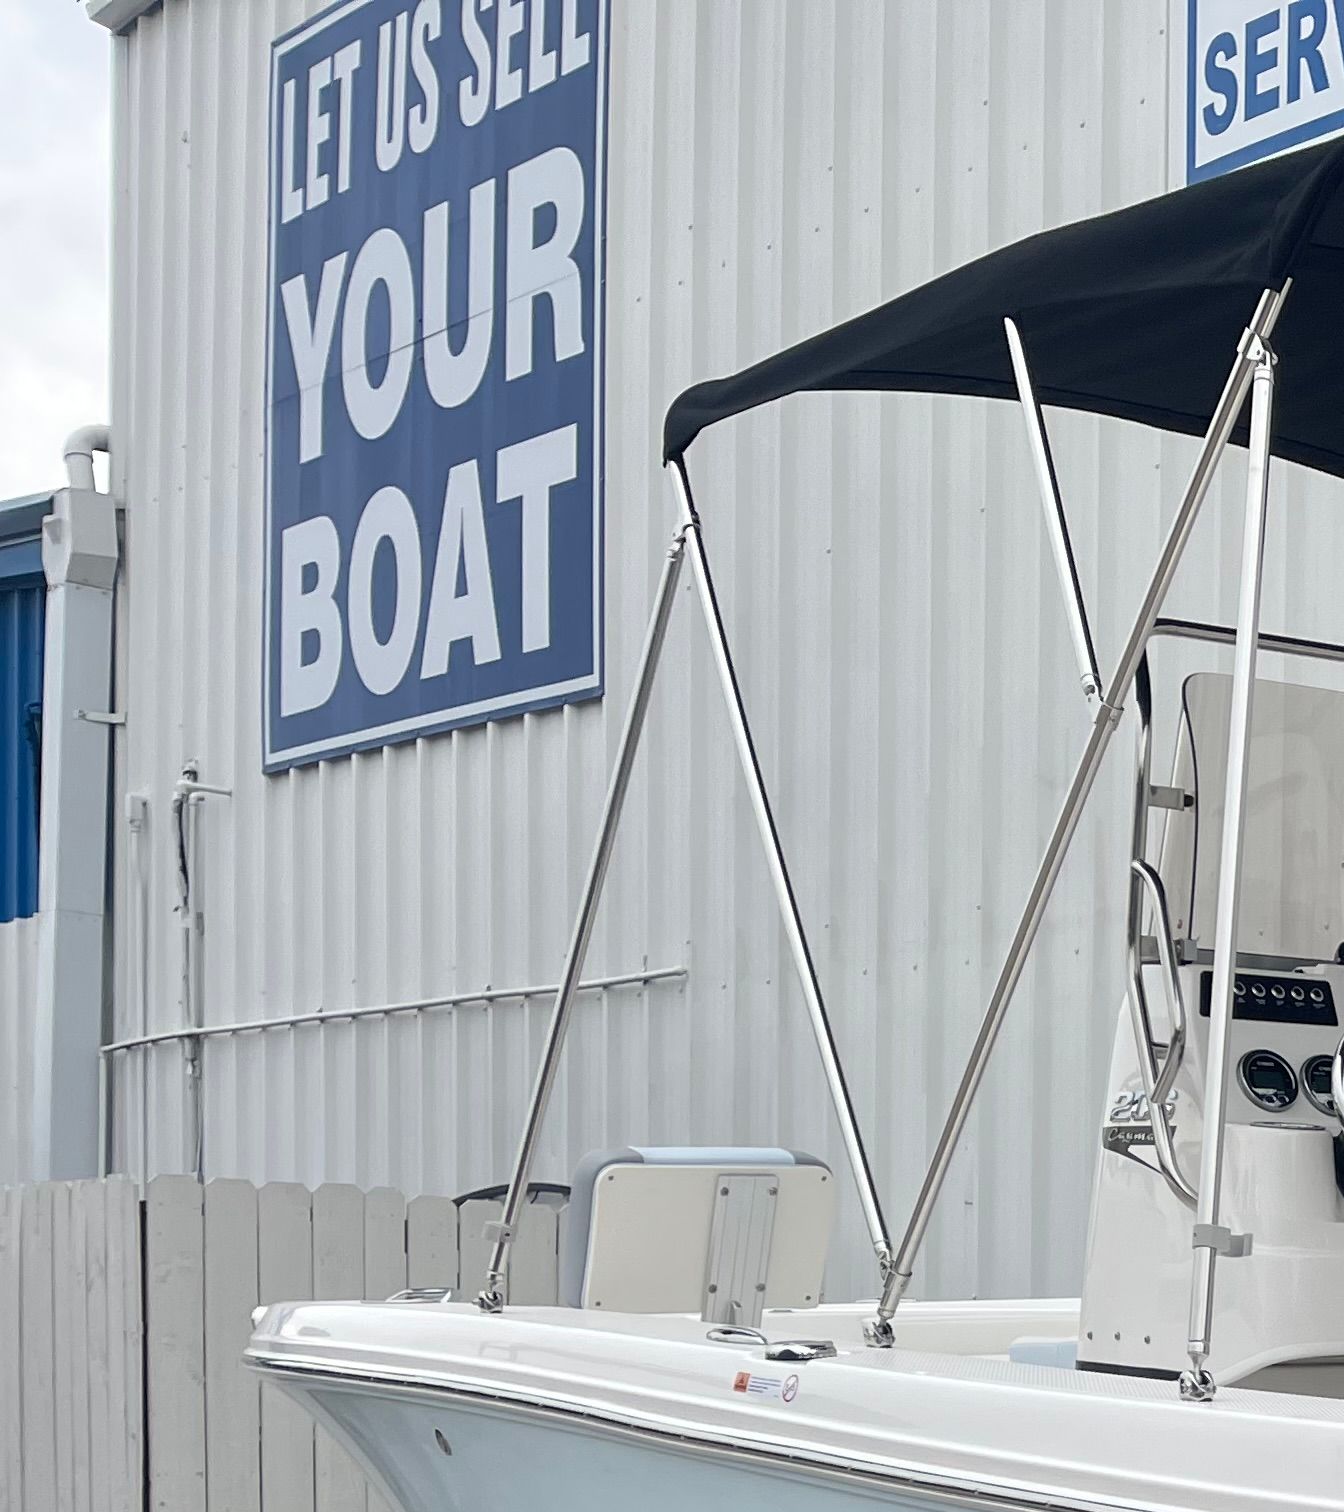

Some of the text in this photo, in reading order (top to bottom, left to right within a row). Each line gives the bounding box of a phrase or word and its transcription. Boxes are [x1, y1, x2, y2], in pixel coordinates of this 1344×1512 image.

[281, 39, 361, 224] LET
[376, 0, 441, 171] US
[281, 146, 585, 464] YOUR
[281, 422, 577, 717] BOAT
[1108, 1127, 1156, 1143] Cayma
